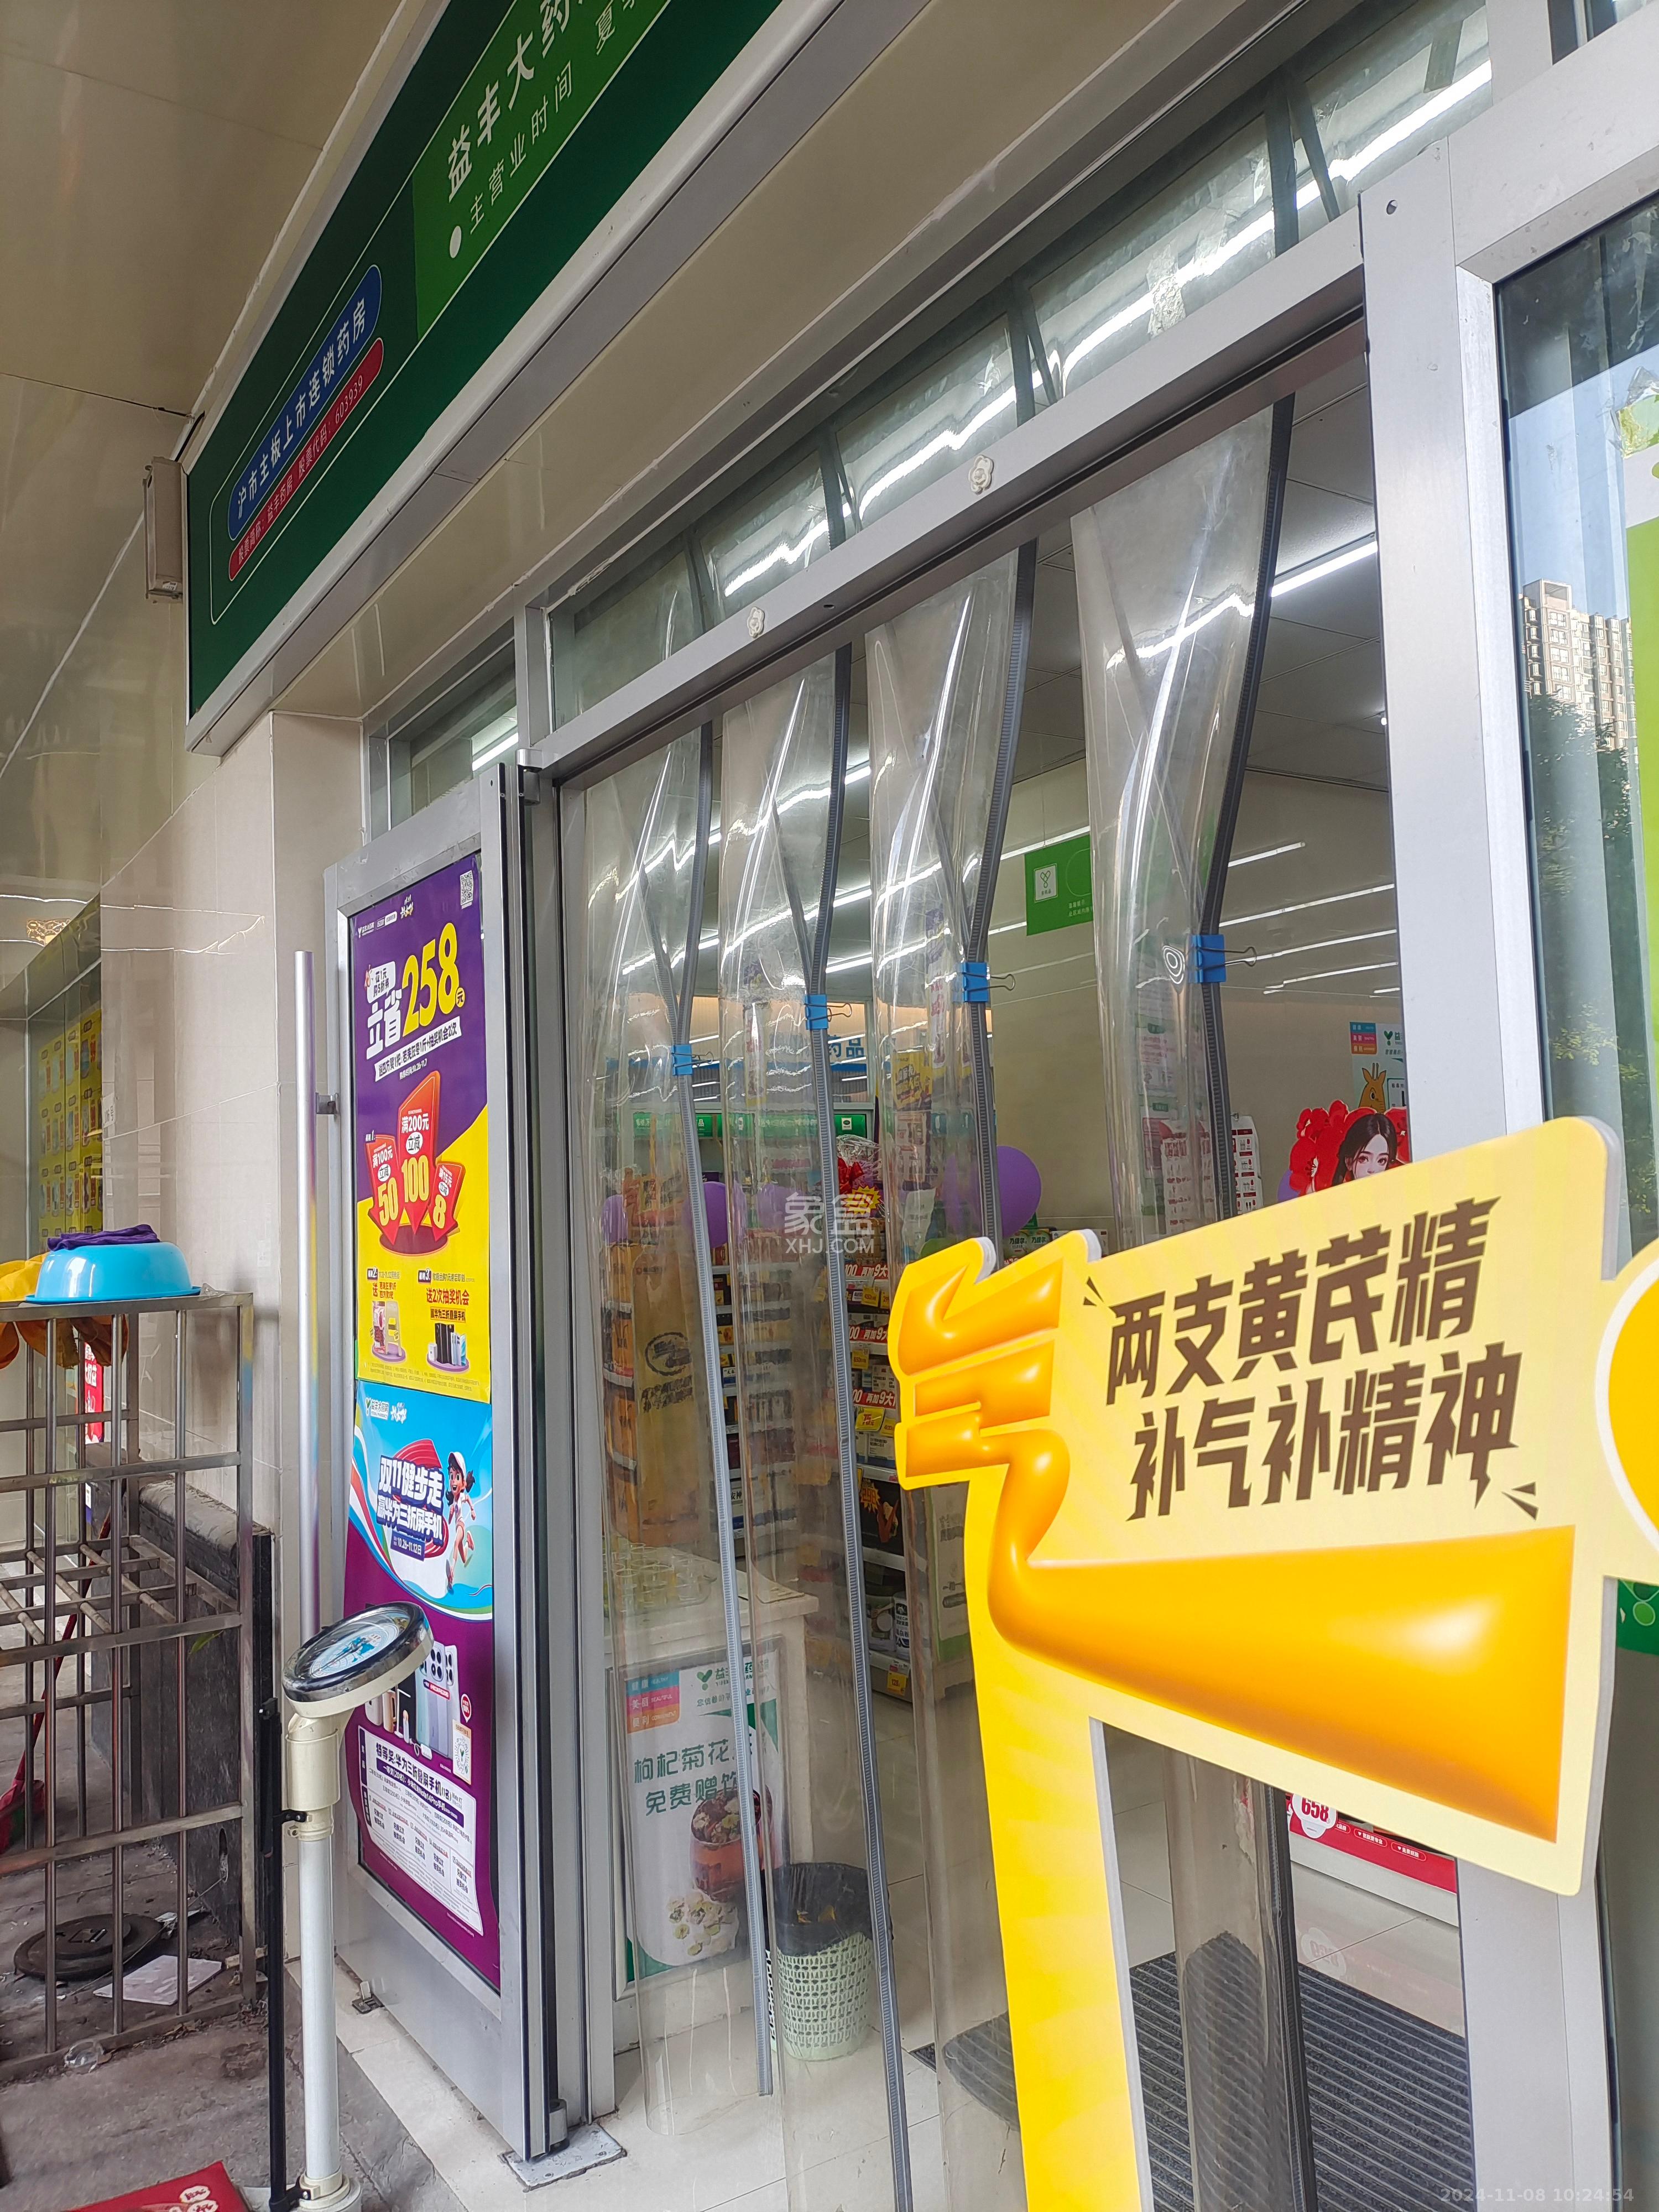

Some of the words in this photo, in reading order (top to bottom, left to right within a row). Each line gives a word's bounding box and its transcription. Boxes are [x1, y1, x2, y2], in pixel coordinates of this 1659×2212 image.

[448, 0, 582, 202] 益丰大药
[470, 60, 572, 235] 主营业时间
[238, 297, 366, 519] 沪市主板上市连锁药房
[401, 922, 460, 1037] 258
[366, 989, 403, 1060] 立省
[401, 1113, 430, 1134] 满200元
[377, 1177, 398, 1227] 50
[401, 1155, 430, 1203] 100
[432, 1193, 447, 1229] 8
[426, 1287, 469, 1306] 送2次抽奖机会
[1106, 1196, 1501, 1406] 两支黄芪精
[1125, 1342, 1523, 1521] 补气补精神
[379, 1457, 443, 1509] 双11健步走
[377, 1494, 443, 1541] 赢华为三折屏手机
[634, 1739, 752, 1783] 枸杞菊花
